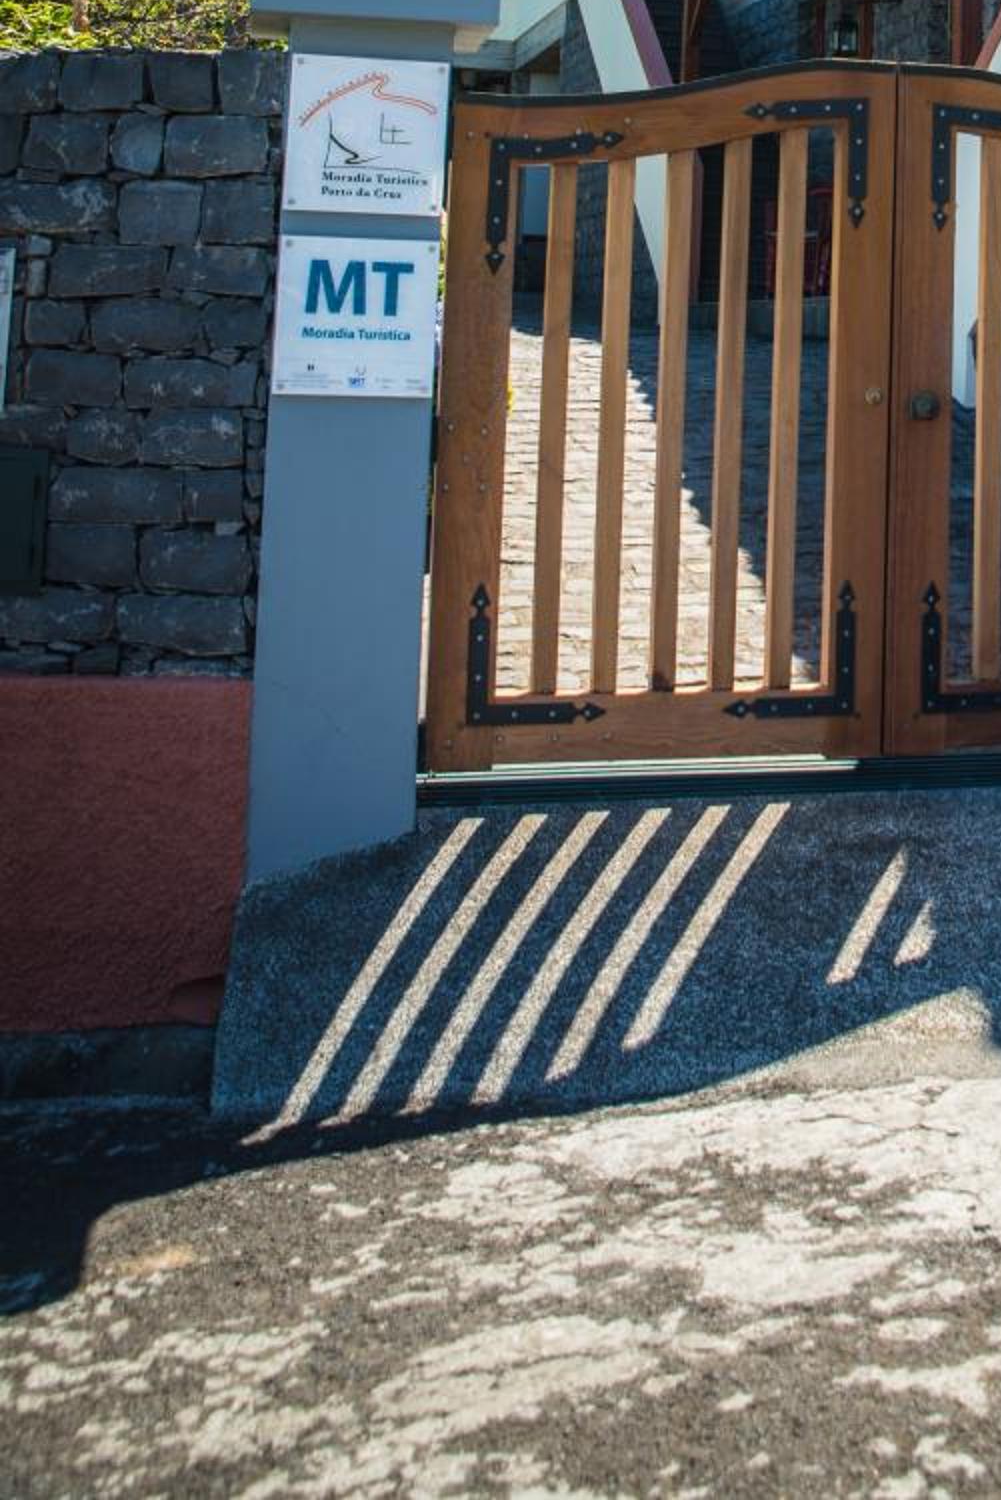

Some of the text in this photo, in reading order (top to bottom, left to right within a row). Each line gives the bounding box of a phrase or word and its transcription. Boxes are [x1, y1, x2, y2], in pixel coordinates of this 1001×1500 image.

[356, 187, 371, 197] da
[304, 259, 415, 317] MT
[302, 326, 355, 340] Moradia
